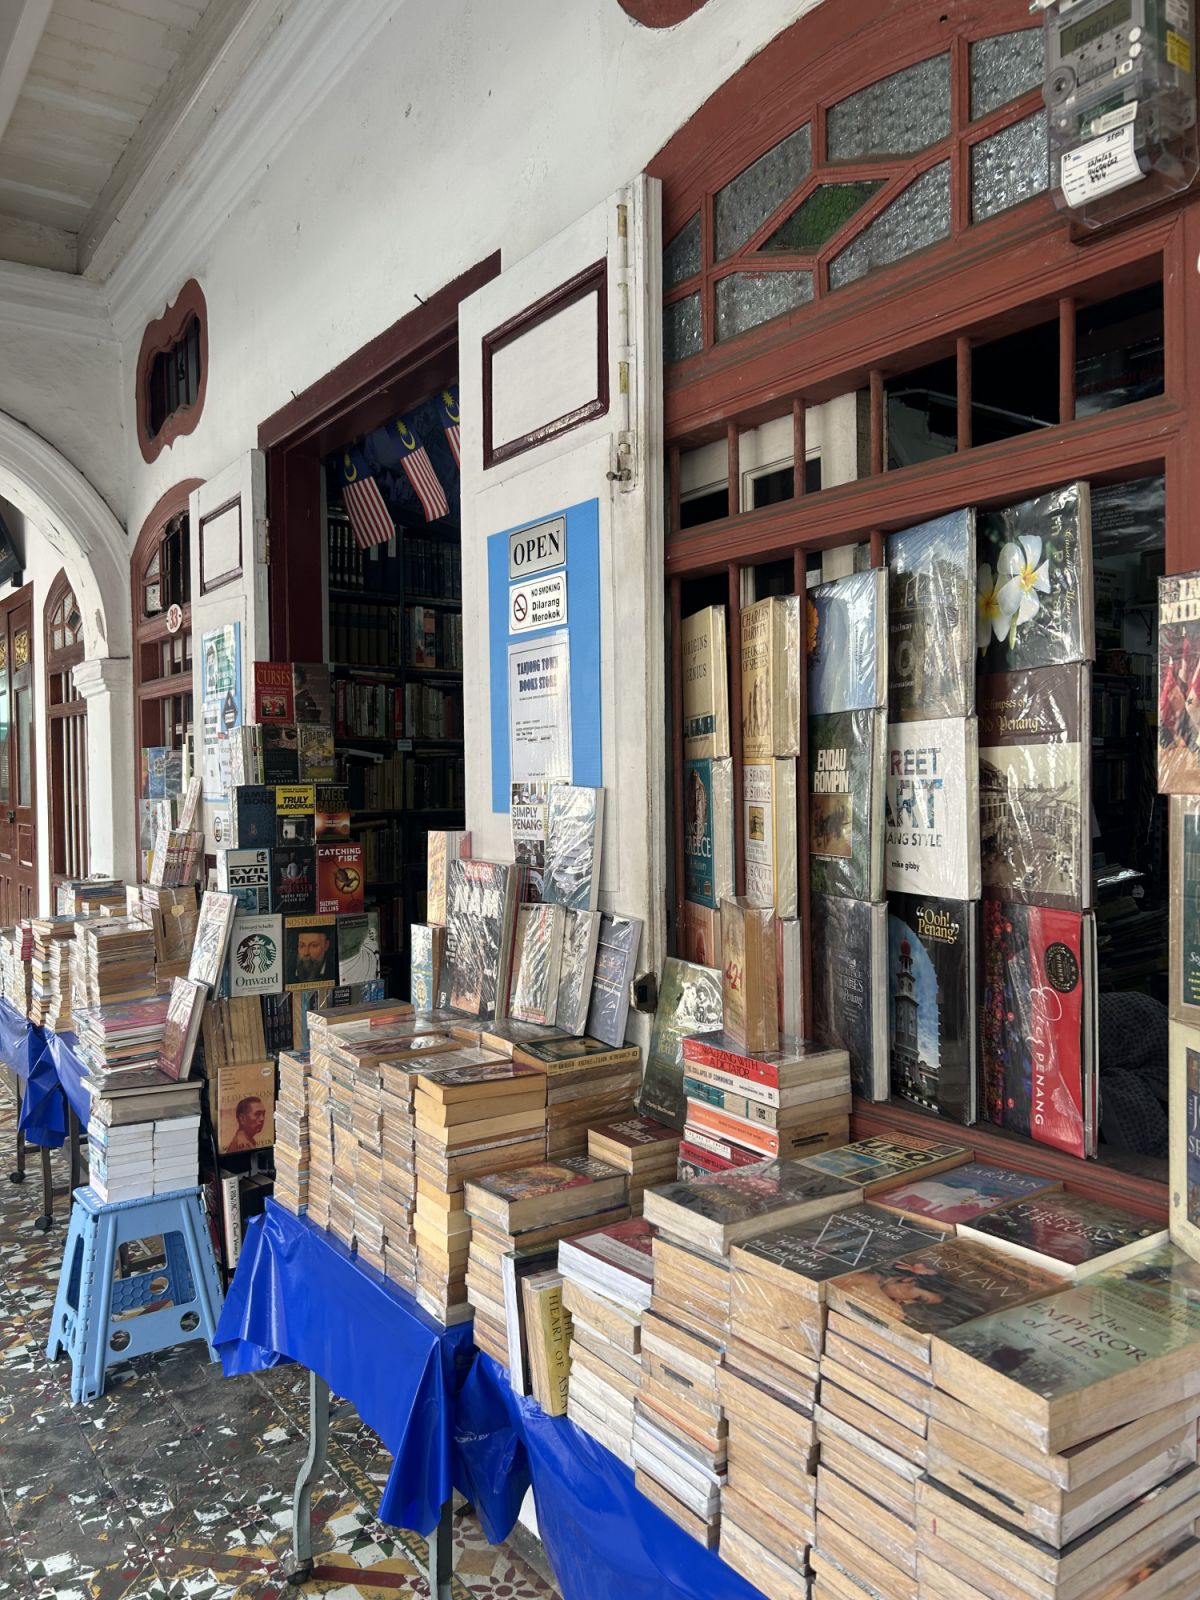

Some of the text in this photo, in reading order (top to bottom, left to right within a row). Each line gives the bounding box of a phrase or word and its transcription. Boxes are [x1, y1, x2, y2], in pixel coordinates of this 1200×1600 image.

[513, 530, 561, 566] OPEN
[531, 582, 561, 598] NO SMOKING
[532, 598, 560, 611] Dilarang
[169, 610, 180, 631] 33
[532, 609, 561, 622] Merokok
[743, 606, 769, 628] CHARLES
[744, 623, 767, 642] DARWIN
[683, 633, 708, 657] ORIGINS
[256, 670, 291, 685] CURSES
[517, 659, 541, 675] TANJONG
[519, 677, 538, 692] BOOKS
[998, 715, 1039, 736] Penang
[817, 748, 847, 771] ENDAU
[890, 747, 942, 775] REET
[814, 770, 849, 793] ROMPIN
[282, 796, 309, 804] TRULY
[320, 789, 345, 801] MEG
[512, 806, 538, 818] SIMPLY
[512, 818, 542, 830] PENANG
[888, 833, 943, 847] ANG STYLE
[318, 847, 361, 857] CATCHING
[337, 854, 358, 862] FIRE
[230, 867, 268, 875] EVIL
[904, 861, 920, 872] gibby
[230, 875, 268, 884] MEN
[287, 916, 336, 926] NOSTRADAMUS
[235, 973, 279, 987] Onward
[701, 1045, 759, 1070] WALTZING WITH
[717, 1060, 751, 1080] DICTATOR
[1034, 1052, 1046, 1125] PENANG
[847, 1144, 920, 1167] MYSTERIES
[858, 1139, 934, 1162] UFO
[560, 1157, 606, 1177] POTTER
[572, 1156, 613, 1175] HARRY
[962, 1166, 1043, 1189] NARAYAN
[838, 1213, 905, 1242] WIND SING
[852, 1211, 911, 1236] HEAR THE
[750, 1239, 825, 1271] MURAKAMI
[776, 1238, 828, 1262] HARUKI
[917, 1250, 975, 1278] TASH
[968, 1277, 1023, 1298] AW
[563, 1315, 573, 1341] THE
[1025, 1301, 1148, 1363] EMPEROR
[1089, 1311, 1128, 1334] The
[1022, 1318, 1110, 1360] of LIES
[548, 1294, 569, 1410] HEART OF ASIA
